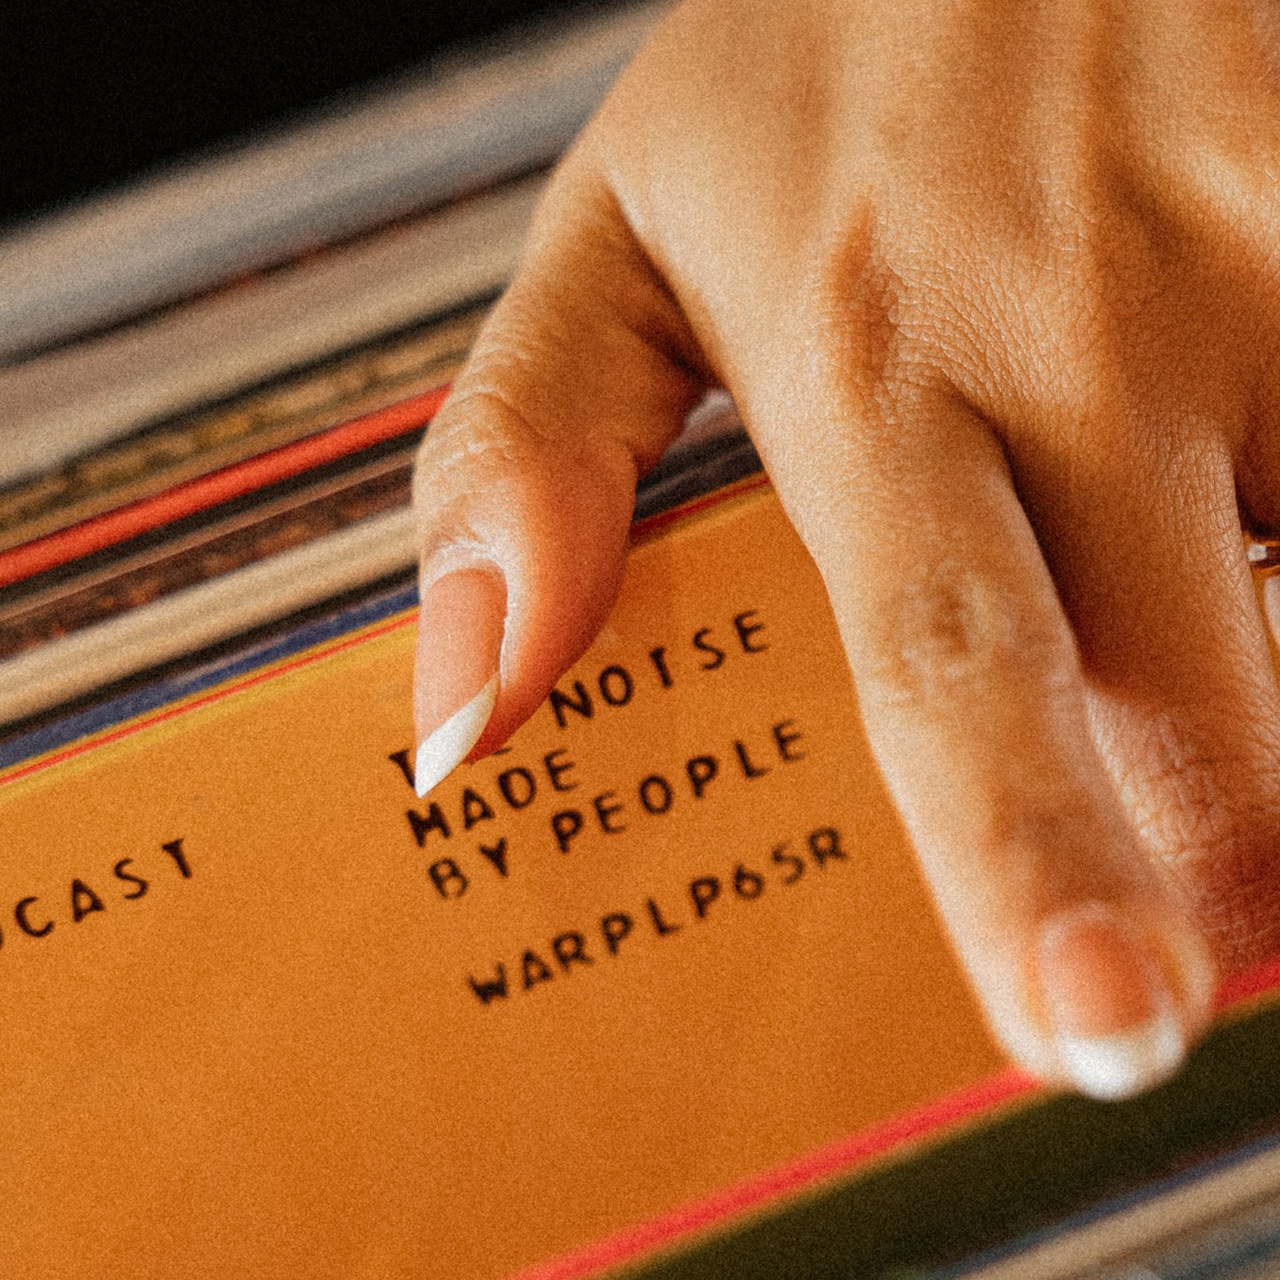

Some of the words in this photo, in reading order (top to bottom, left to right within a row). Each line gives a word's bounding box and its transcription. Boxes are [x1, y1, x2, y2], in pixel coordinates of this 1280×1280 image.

[549, 609, 770, 729] NOISE
[405, 747, 580, 847] MADE
[426, 837, 511, 900] BY
[551, 719, 806, 854] PEOPLE
[0, 837, 193, 952] CAST
